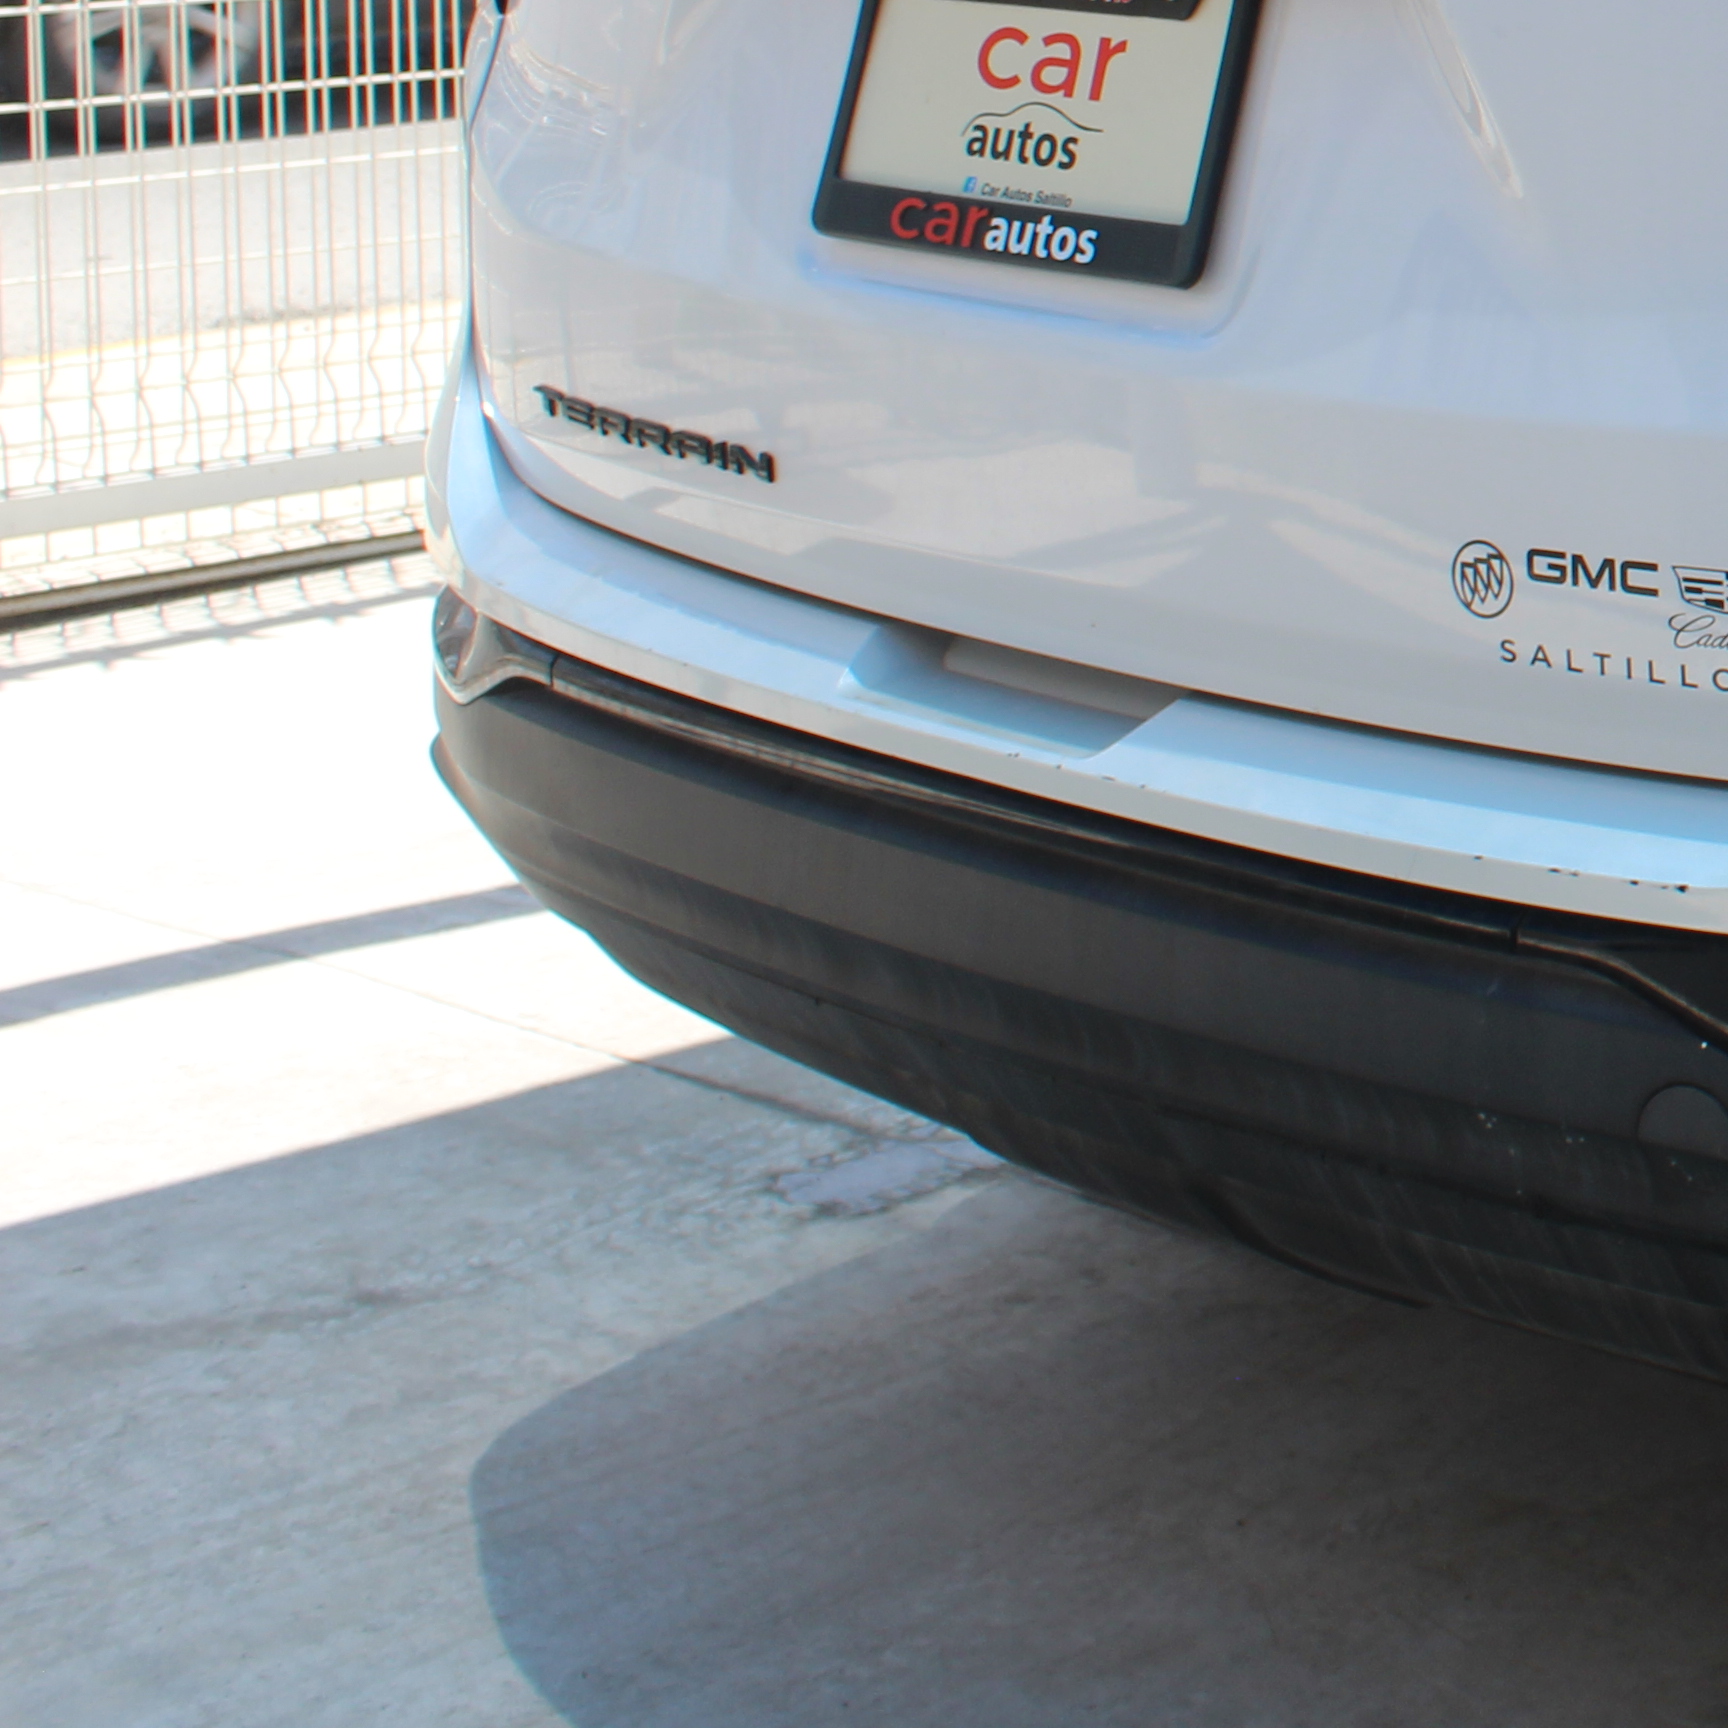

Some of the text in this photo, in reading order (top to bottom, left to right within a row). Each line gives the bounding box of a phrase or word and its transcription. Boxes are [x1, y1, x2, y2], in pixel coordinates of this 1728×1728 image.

[977, 24, 1127, 102] car
[965, 120, 1079, 171] autos
[981, 182, 1000, 196] Car
[1001, 186, 1034, 203] Autos
[533, 383, 779, 484] TERRAIN
[1526, 547, 1660, 597] GMC
